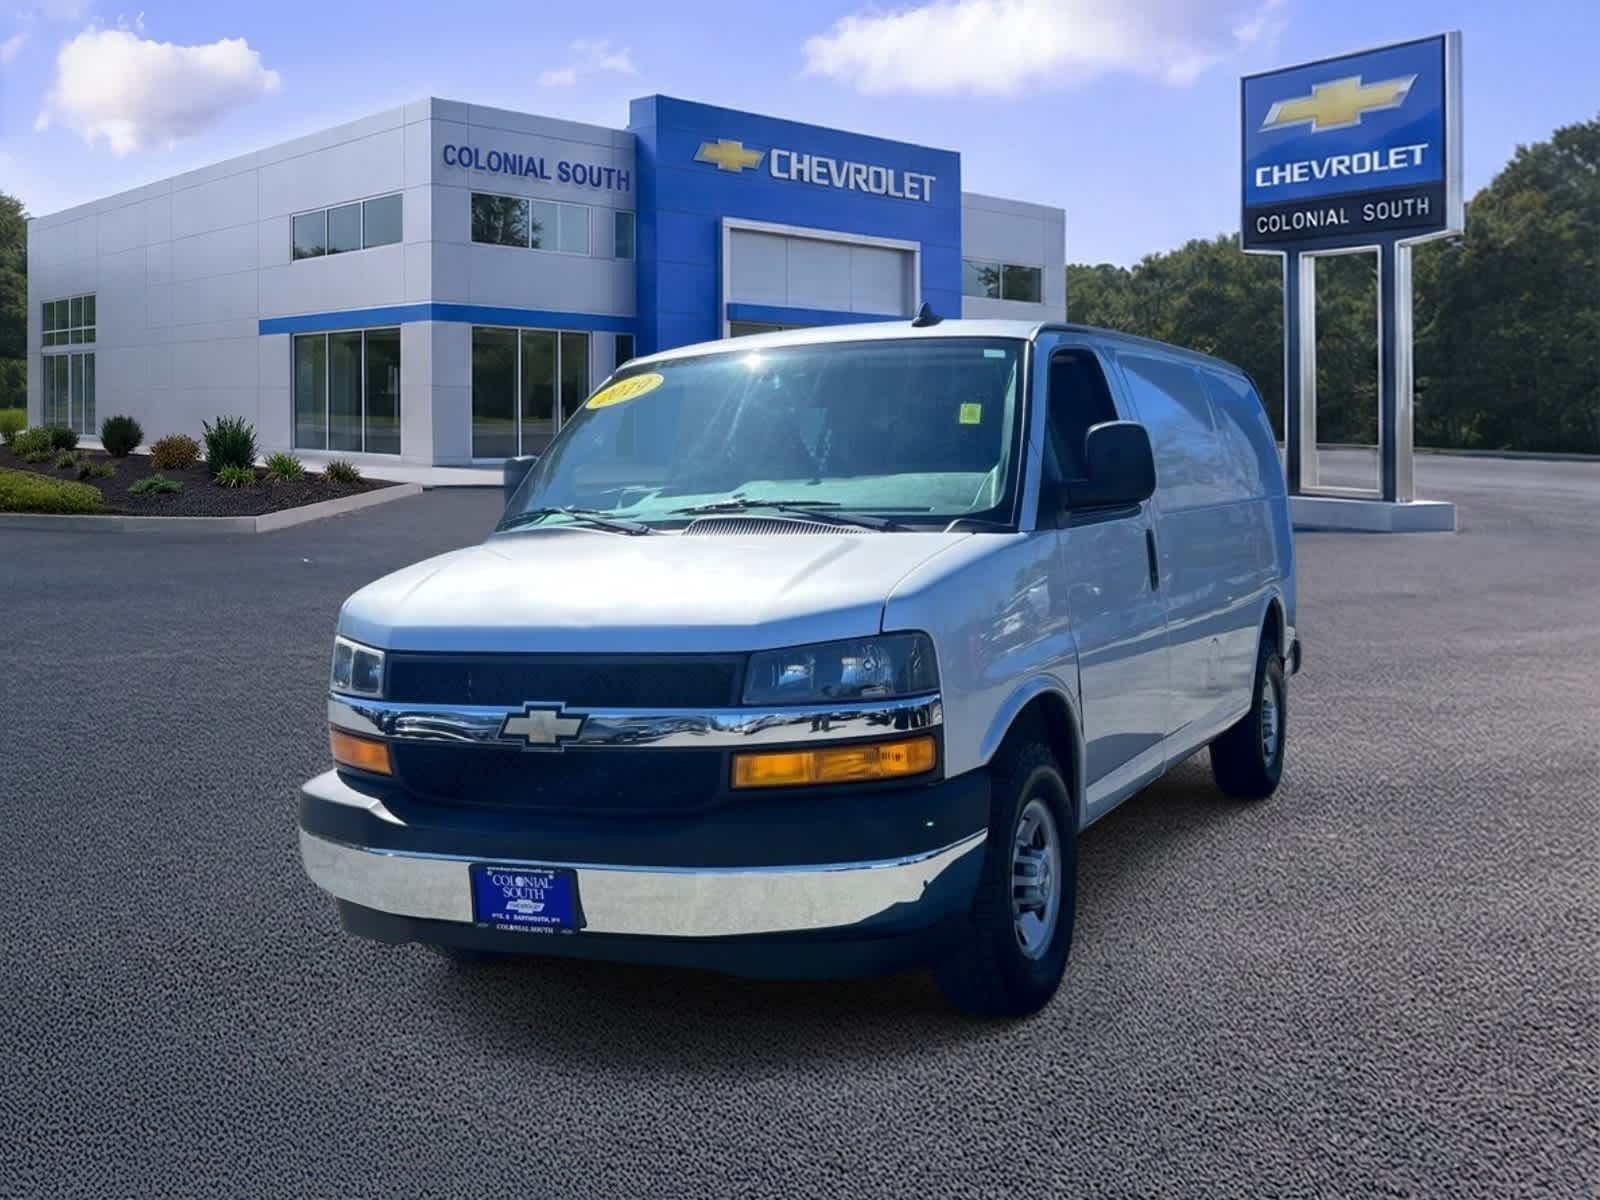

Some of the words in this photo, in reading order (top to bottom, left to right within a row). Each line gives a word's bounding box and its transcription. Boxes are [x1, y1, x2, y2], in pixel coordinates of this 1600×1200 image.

[443, 144, 552, 180] COLONIAL
[557, 160, 631, 192] SOUTH
[770, 148, 937, 203] CHEVROLET
[1255, 143, 1429, 187] CHEVROLET
[1256, 208, 1349, 233] COLONIAL
[1362, 197, 1429, 222] SOUTH
[492, 873, 552, 888] COLONIAL
[502, 887, 544, 899] SOUTH
